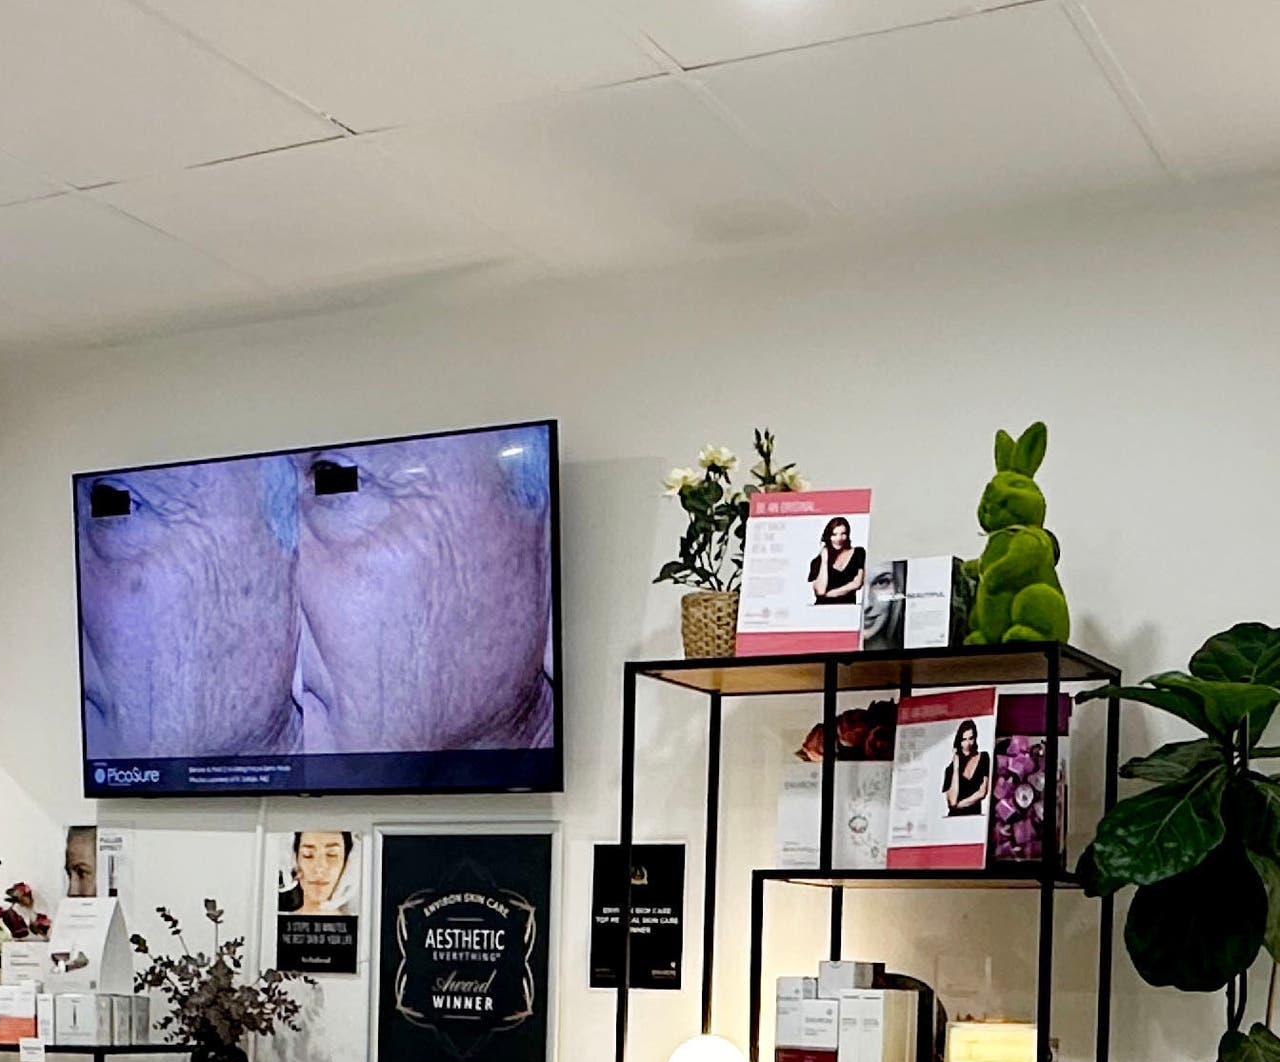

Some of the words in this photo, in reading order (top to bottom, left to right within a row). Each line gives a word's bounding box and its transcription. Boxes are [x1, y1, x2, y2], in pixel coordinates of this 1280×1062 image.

[107, 767, 160, 783] PicoSure
[424, 927, 506, 951] AESTHETIC
[431, 968, 498, 994] Award
[431, 995, 494, 1011] WINNER
